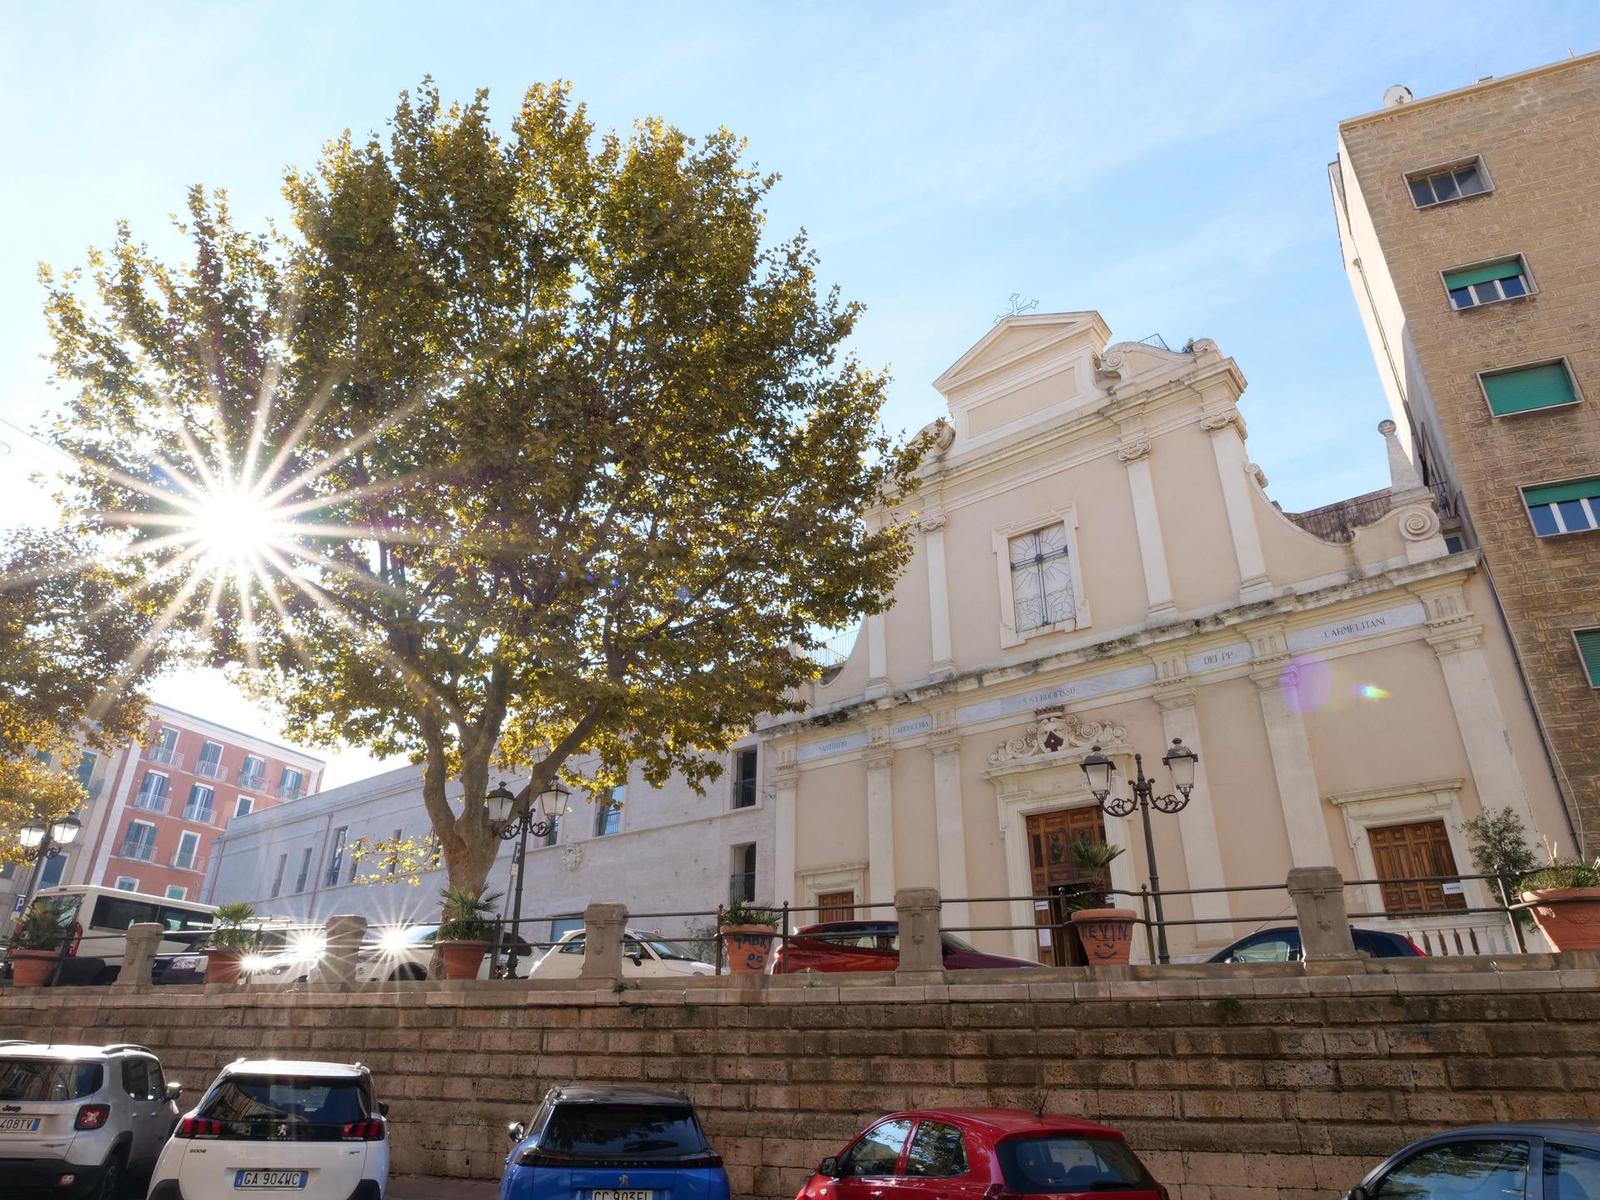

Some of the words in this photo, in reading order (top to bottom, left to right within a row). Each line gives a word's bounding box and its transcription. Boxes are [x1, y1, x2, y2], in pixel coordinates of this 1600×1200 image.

[1203, 654, 1218, 665] DEI
[1324, 616, 1387, 638] CARMELITANI
[16, 897, 25, 910] P
[243, 1172, 259, 1186] GA
